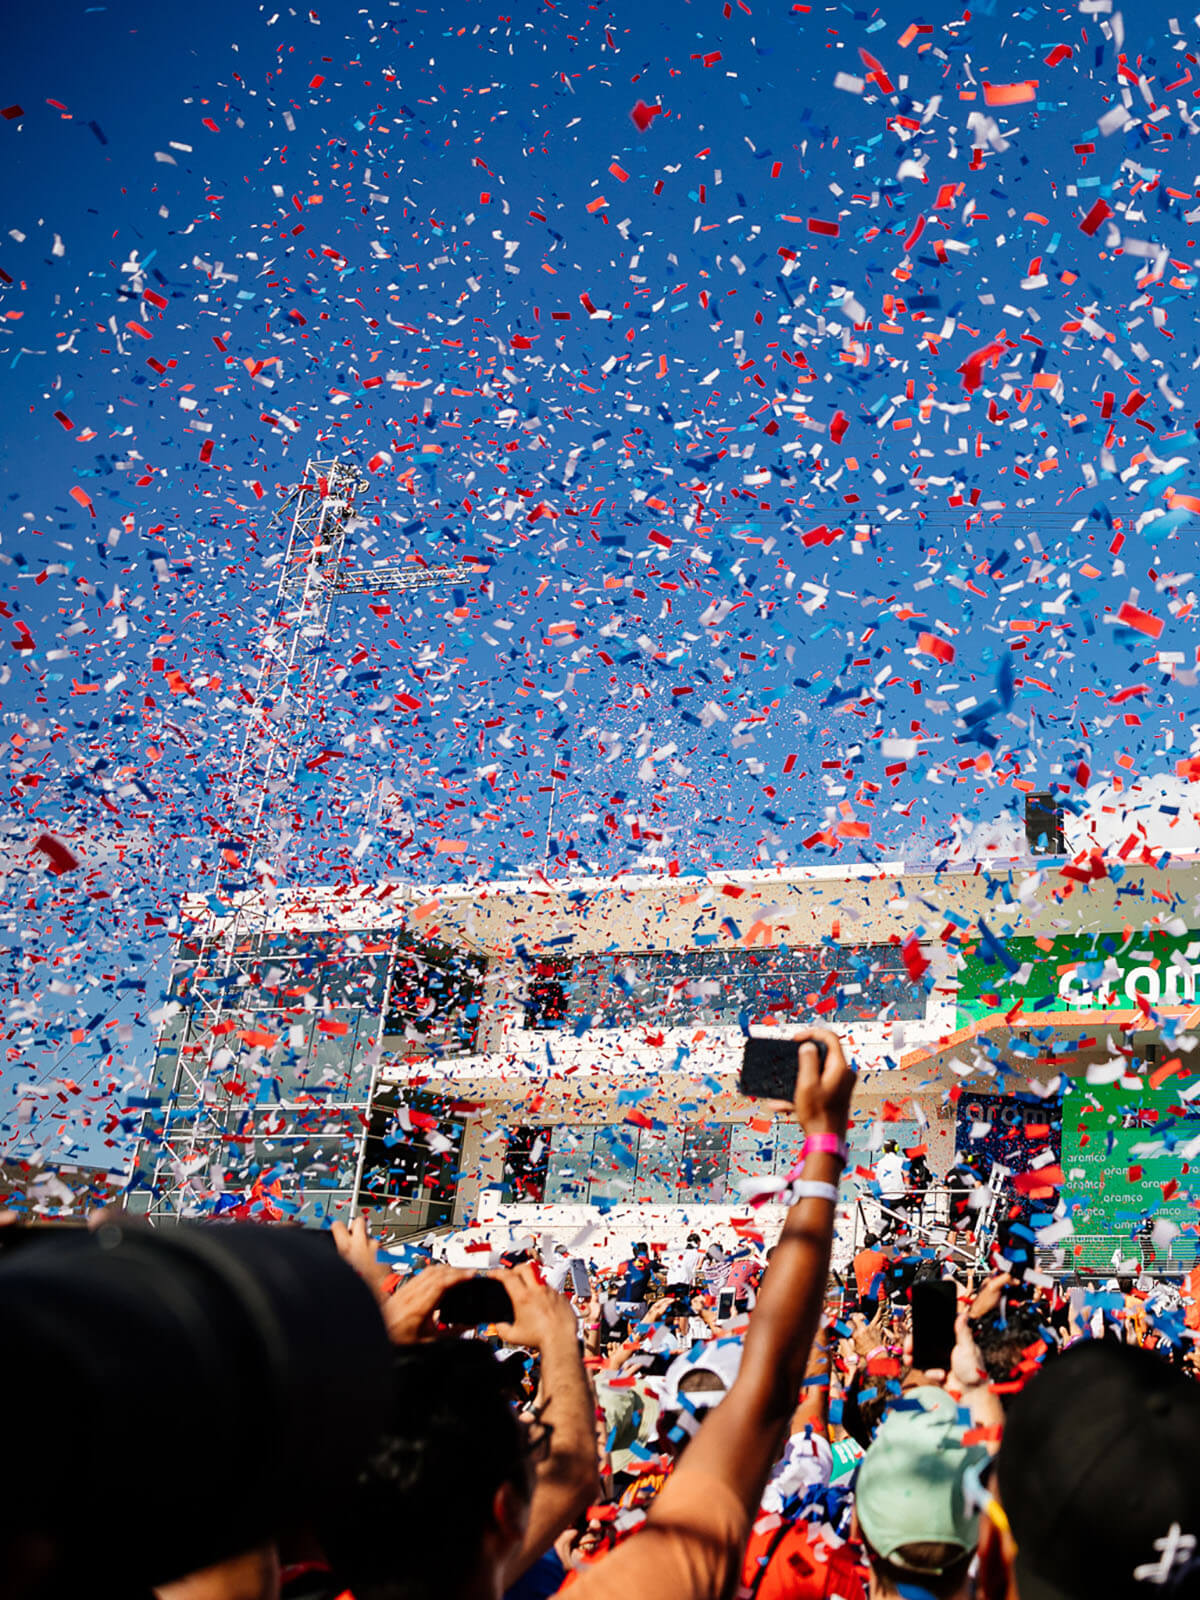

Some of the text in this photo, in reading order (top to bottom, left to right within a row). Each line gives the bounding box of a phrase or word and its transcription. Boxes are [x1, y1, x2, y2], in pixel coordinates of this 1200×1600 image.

[965, 1102, 1057, 1126] aram
[1104, 1167, 1131, 1176] aram
[1141, 1180, 1182, 1189] aramo
[1103, 1194, 1144, 1203] aramco
[1072, 1207, 1105, 1217] ramco
